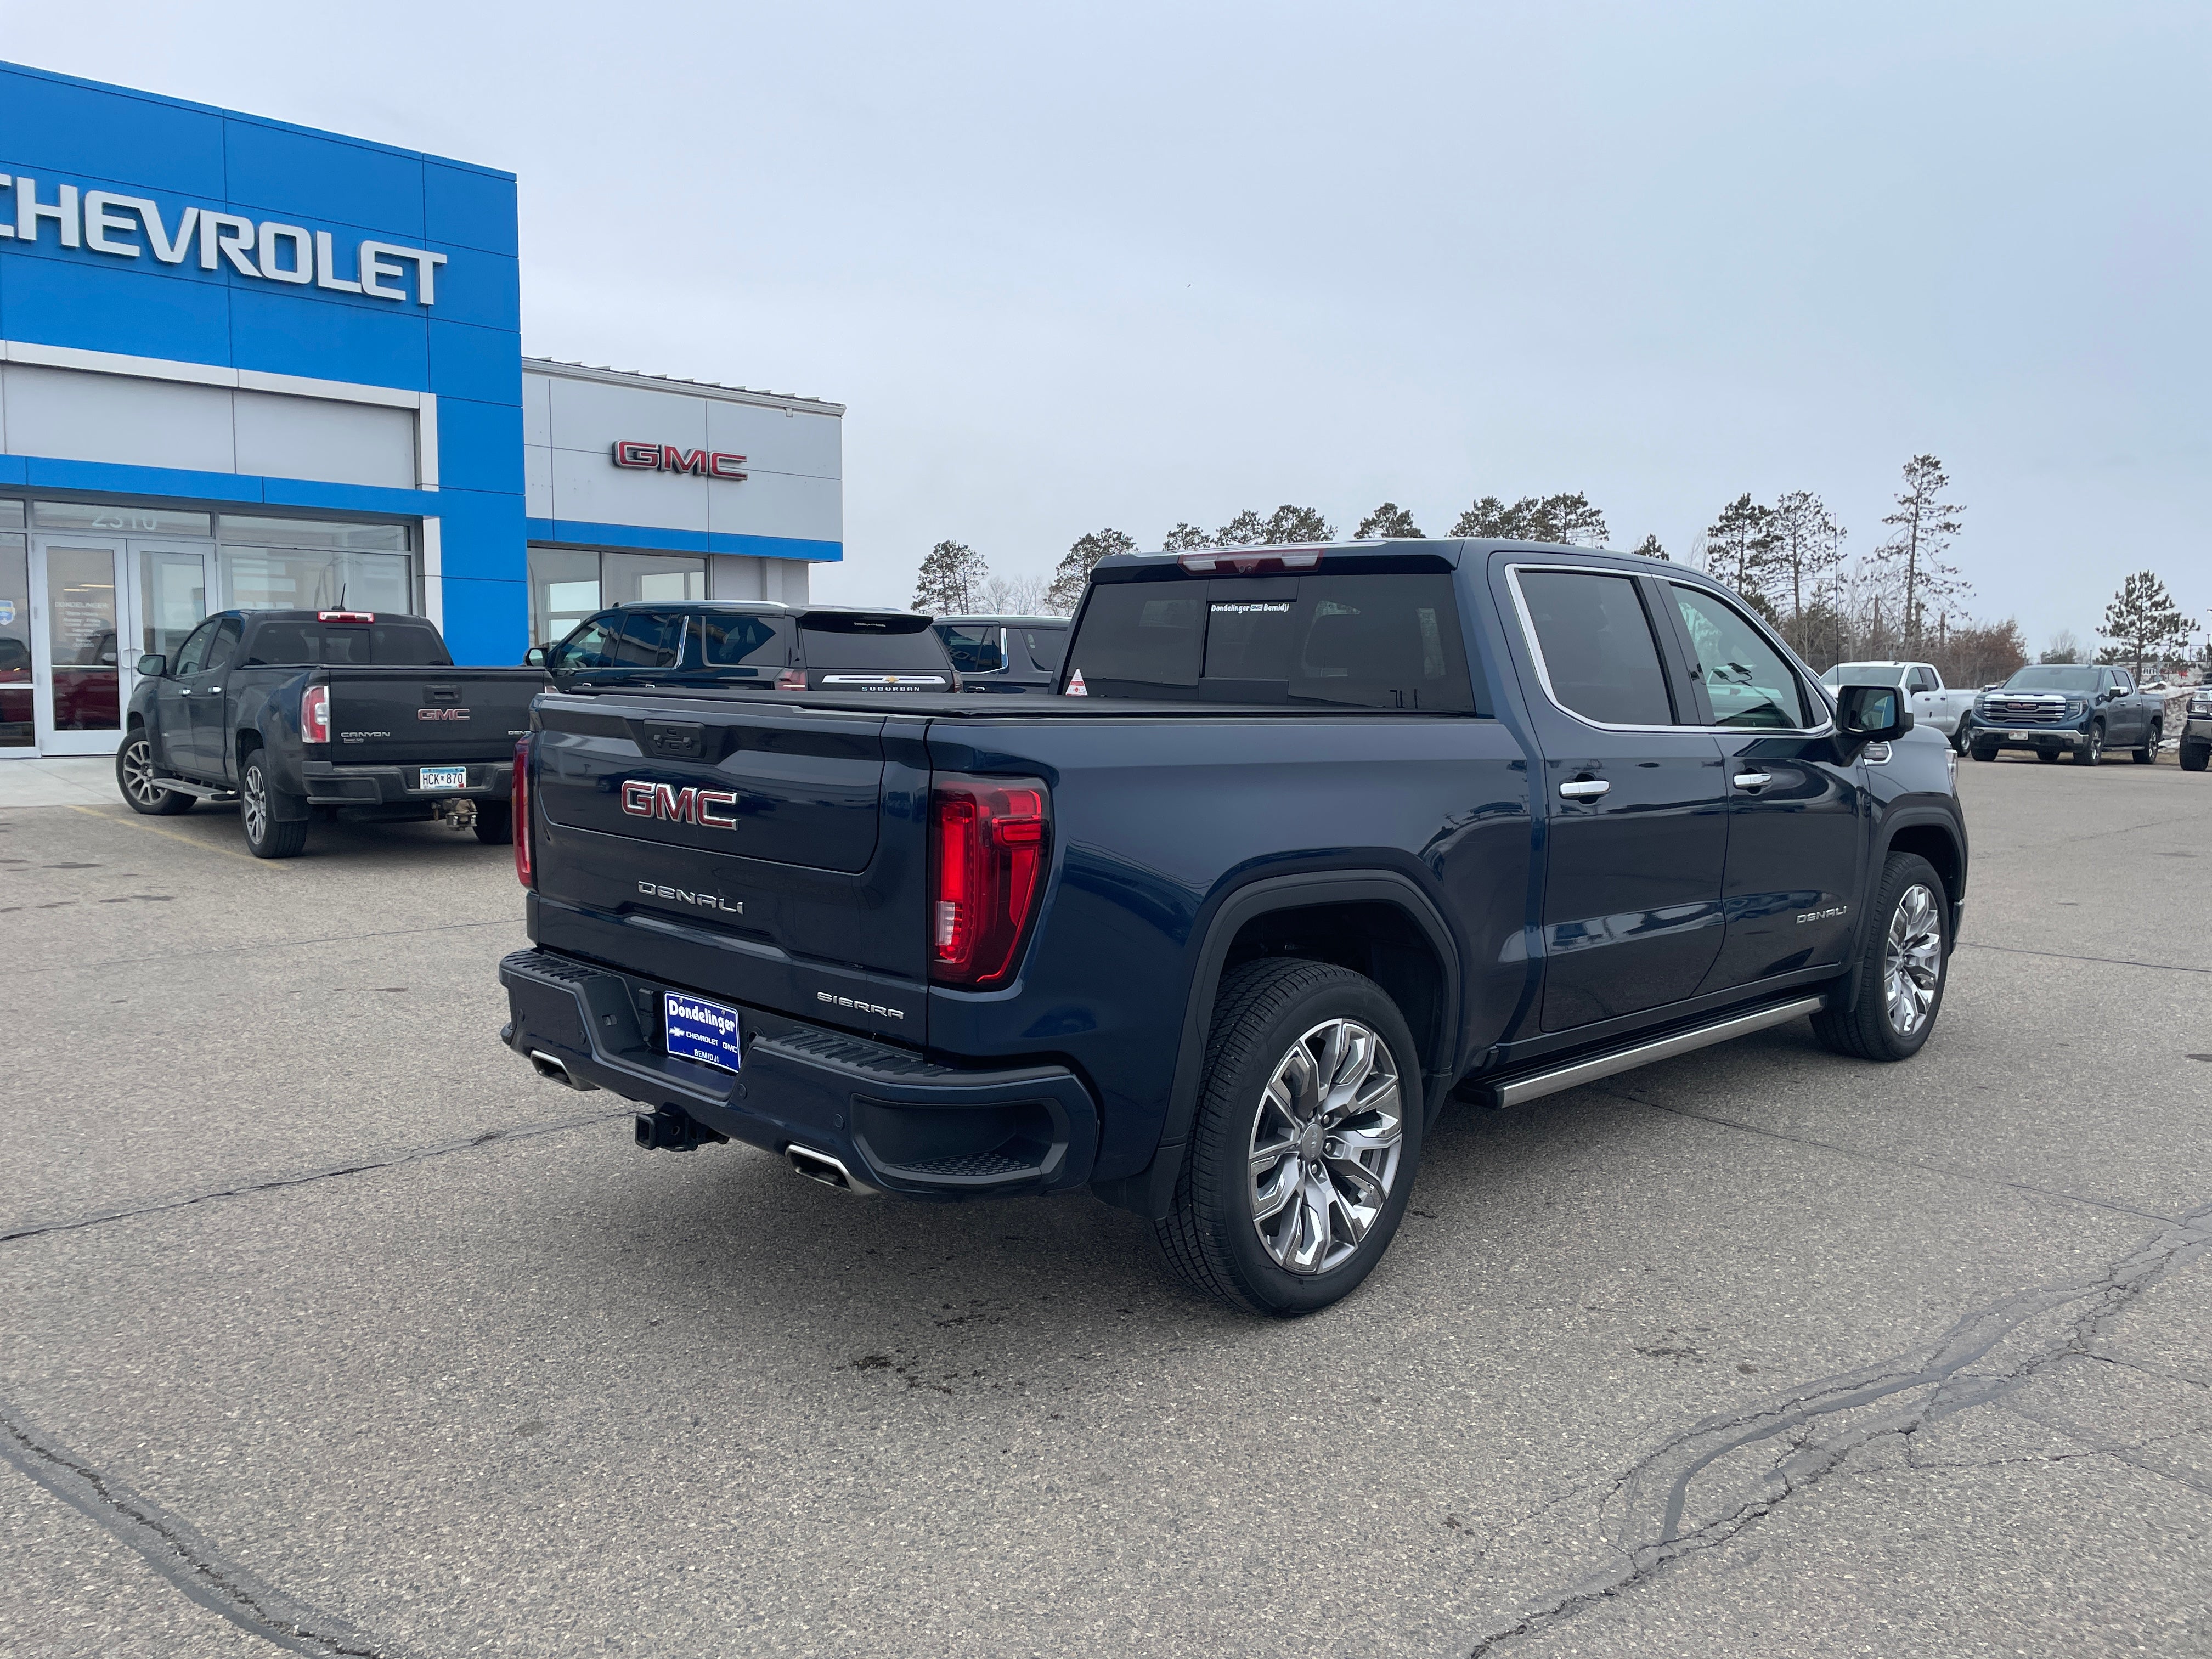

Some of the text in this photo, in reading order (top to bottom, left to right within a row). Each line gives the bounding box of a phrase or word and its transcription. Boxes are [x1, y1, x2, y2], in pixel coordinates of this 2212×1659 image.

[612, 439, 749, 481] GMC
[1211, 604, 1250, 614] Dondelinger
[1263, 603, 1289, 613] Bemidji
[418, 708, 470, 720] GMC
[422, 773, 463, 785] HCK 870
[621, 779, 740, 831] GMC
[638, 880, 743, 915] DENALI
[1796, 905, 1847, 924] DENALI
[668, 999, 735, 1035] Dondelinger
[817, 991, 904, 1020] SIERRA
[686, 1031, 738, 1054] CHEVROLET GMC
[694, 1048, 719, 1063] BEMIDJI
